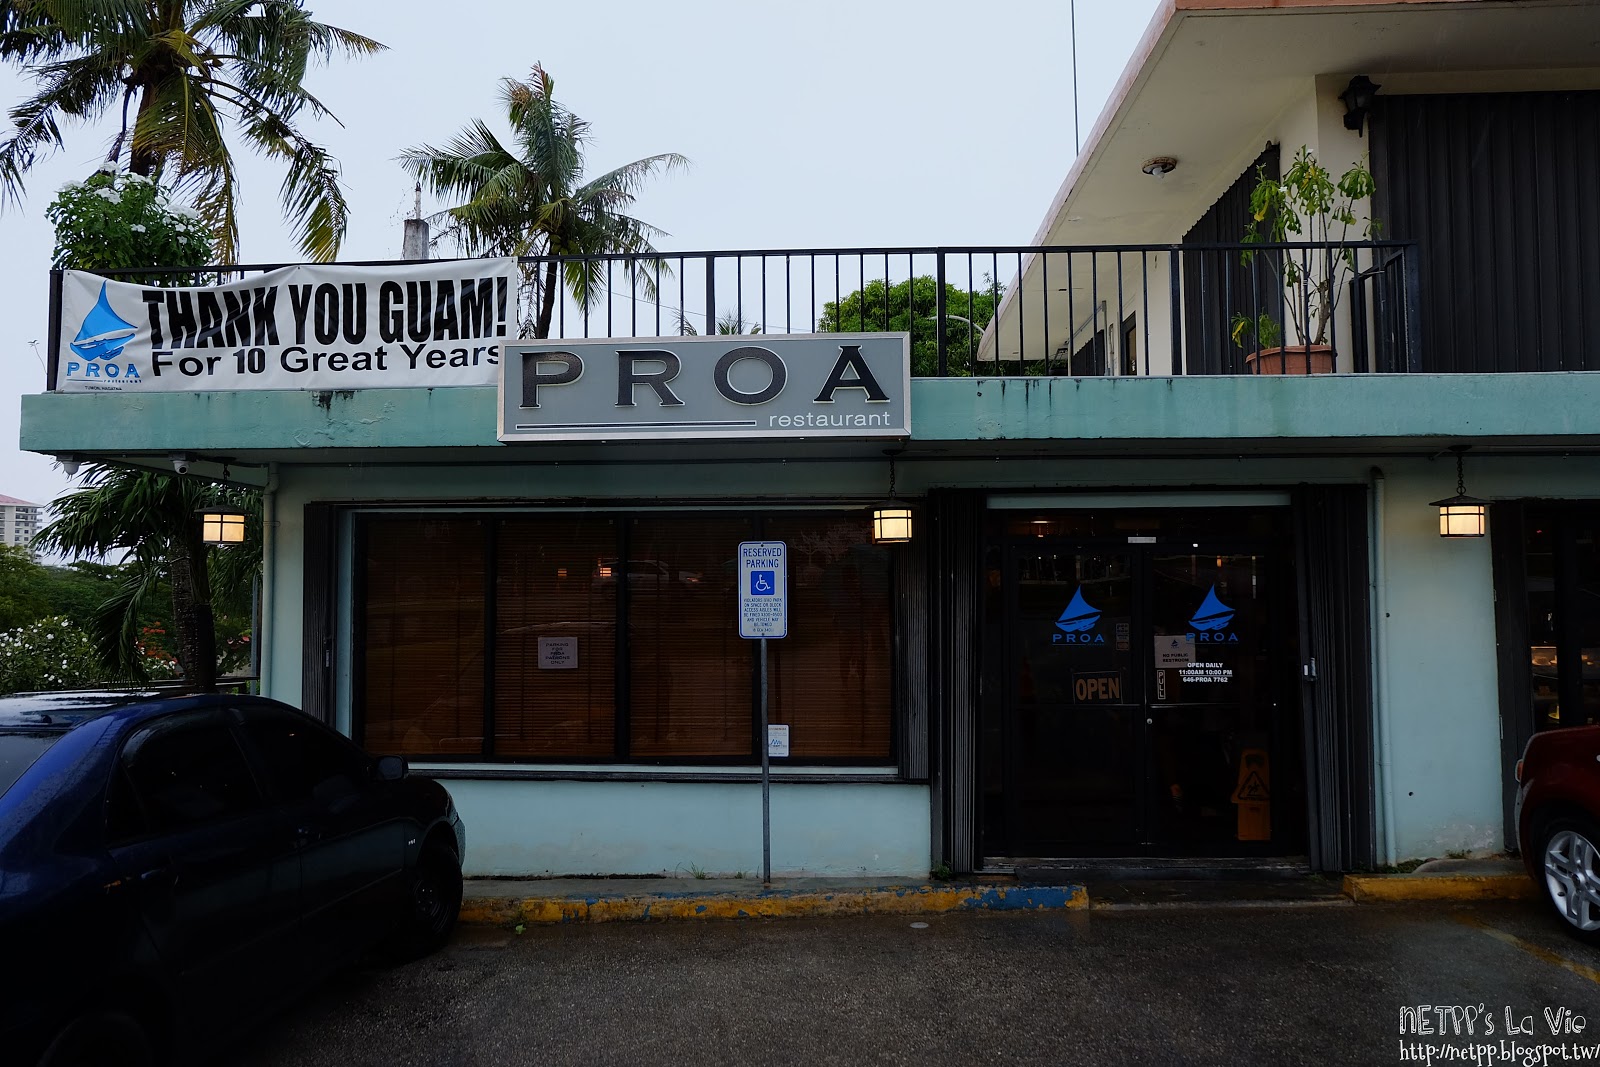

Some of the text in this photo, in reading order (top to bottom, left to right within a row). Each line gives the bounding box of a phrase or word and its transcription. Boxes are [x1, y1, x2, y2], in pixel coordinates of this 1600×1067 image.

[142, 277, 508, 349] THANK YOU GUAM!
[152, 344, 499, 376] For 10 Great Years
[66, 362, 141, 378] PROA
[518, 344, 891, 409] PROA
[769, 411, 890, 427] restaurant
[743, 548, 782, 557] RESERVED
[746, 559, 779, 568] PARKING
[1052, 633, 1105, 643] PROA
[1185, 632, 1239, 642] PROA
[1075, 677, 1120, 701] OPEN
